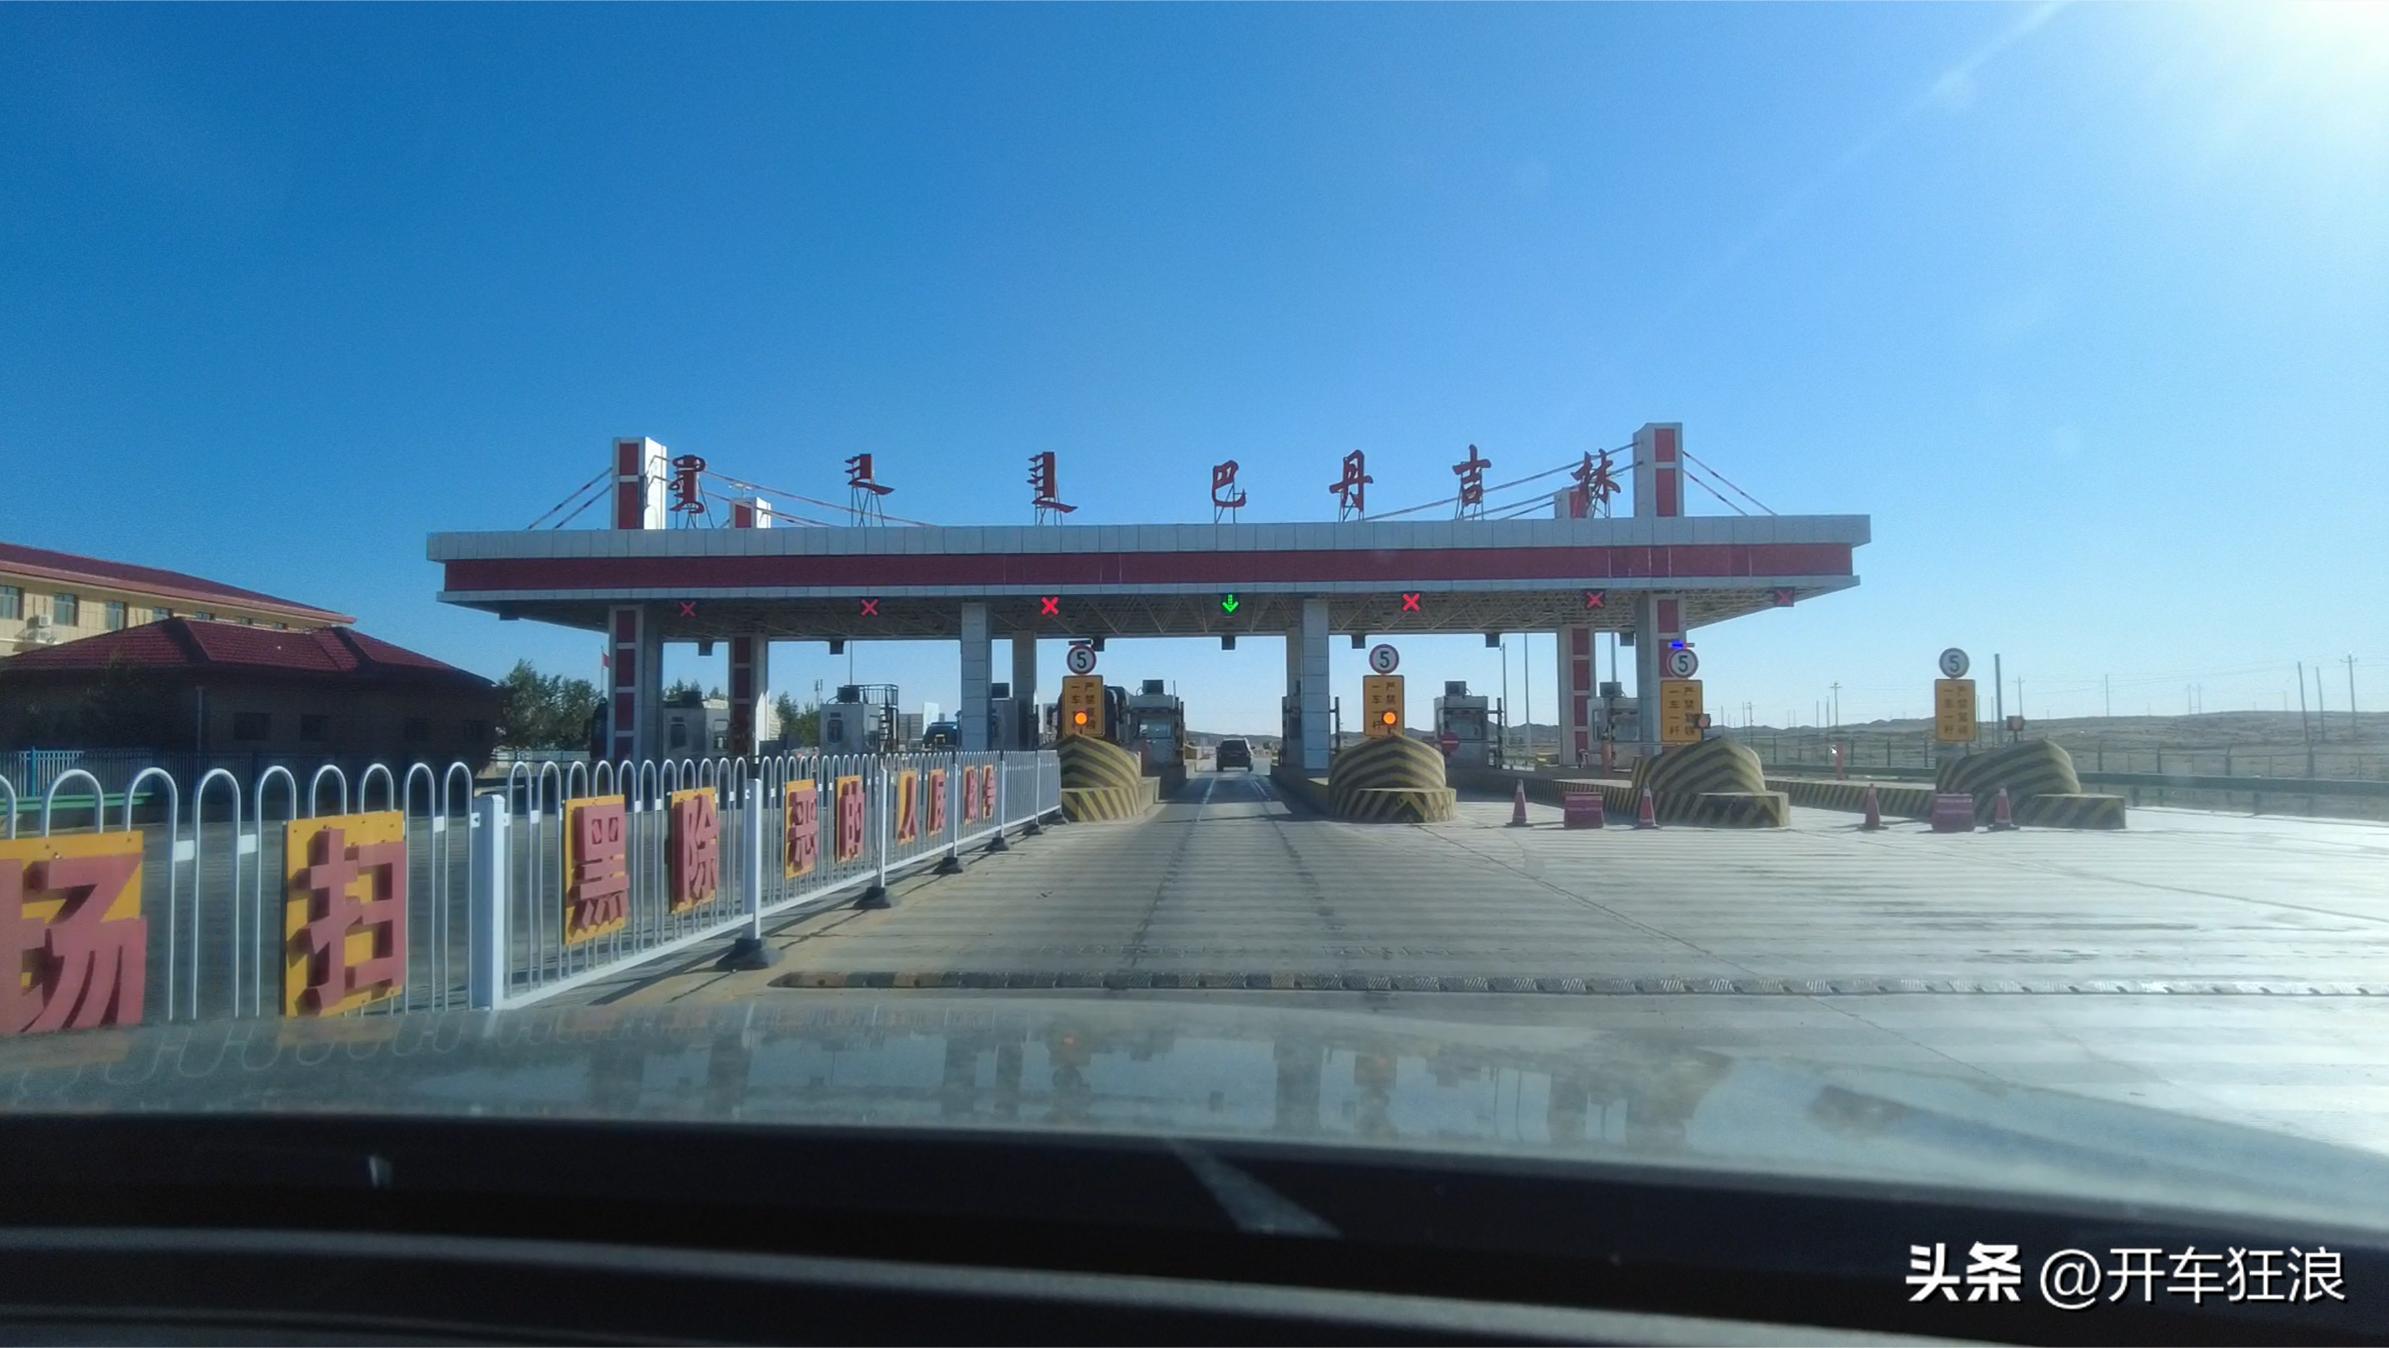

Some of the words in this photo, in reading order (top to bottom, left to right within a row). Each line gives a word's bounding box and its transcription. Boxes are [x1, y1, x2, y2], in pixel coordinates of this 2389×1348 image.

[1212, 444, 1621, 508] 巴丹吉林
[1076, 651, 1087, 669] 5
[1380, 651, 1390, 668] 5
[1678, 655, 1688, 672] 5
[1949, 654, 1960, 673] 5
